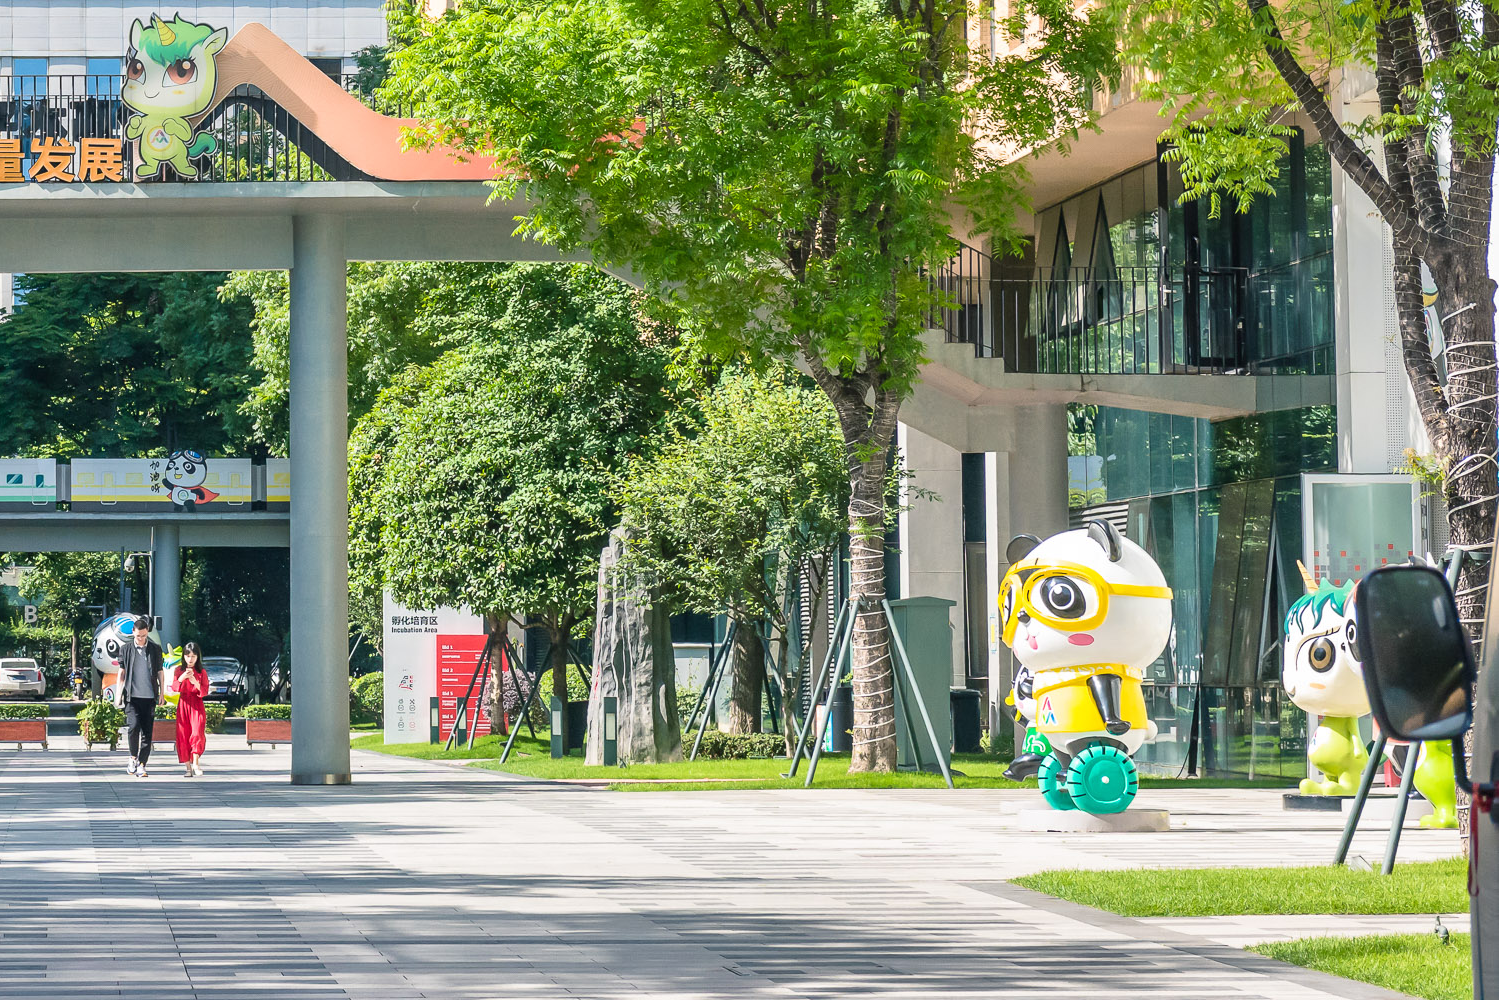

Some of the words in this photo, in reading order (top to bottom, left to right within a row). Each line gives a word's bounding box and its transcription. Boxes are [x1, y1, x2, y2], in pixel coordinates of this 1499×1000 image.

[149, 461, 161, 493] 加油呀
[24, 604, 38, 623] B
[391, 616, 438, 625] 孵化培育区
